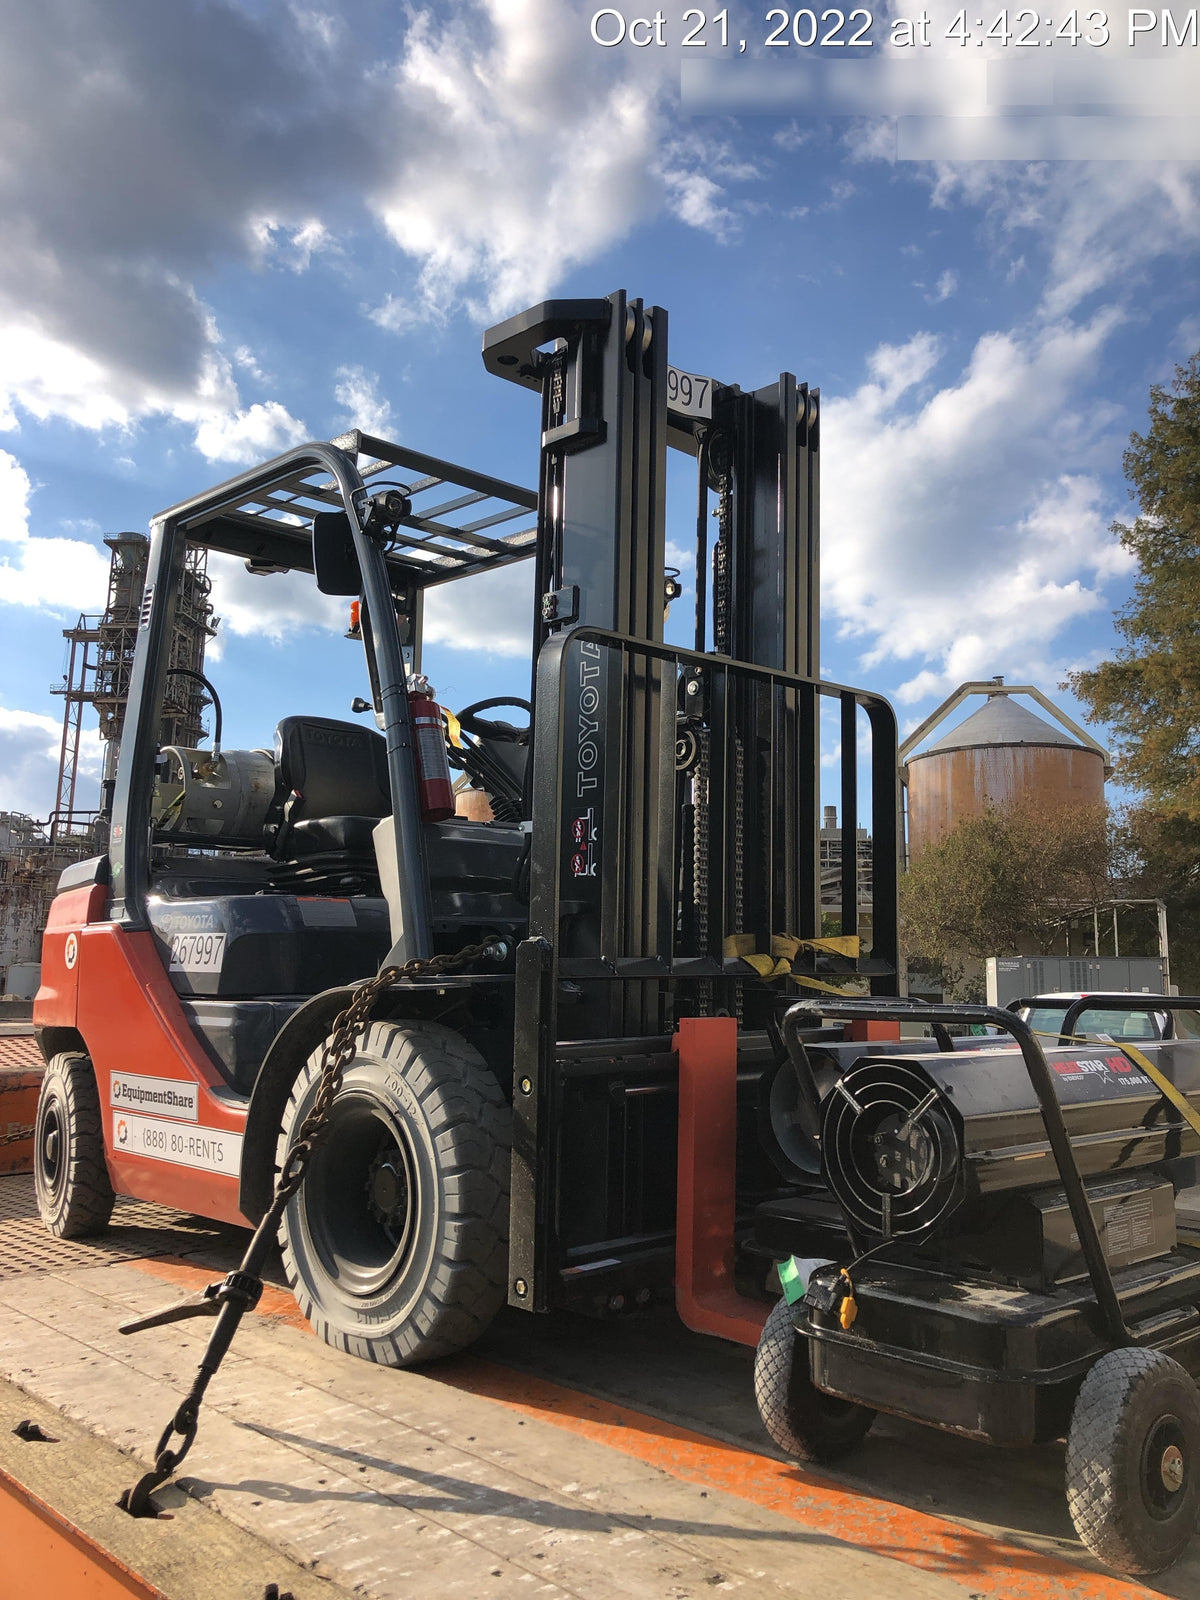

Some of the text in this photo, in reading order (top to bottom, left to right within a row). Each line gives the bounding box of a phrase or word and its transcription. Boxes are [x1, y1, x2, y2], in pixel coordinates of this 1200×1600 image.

[173, 914, 214, 929] TOYOTA
[170, 935, 225, 965] 267997
[1105, 1056, 1132, 1073] HD
[121, 1083, 194, 1108] EquipmentShare
[142, 1127, 224, 1162] (888) 80-RENTS
